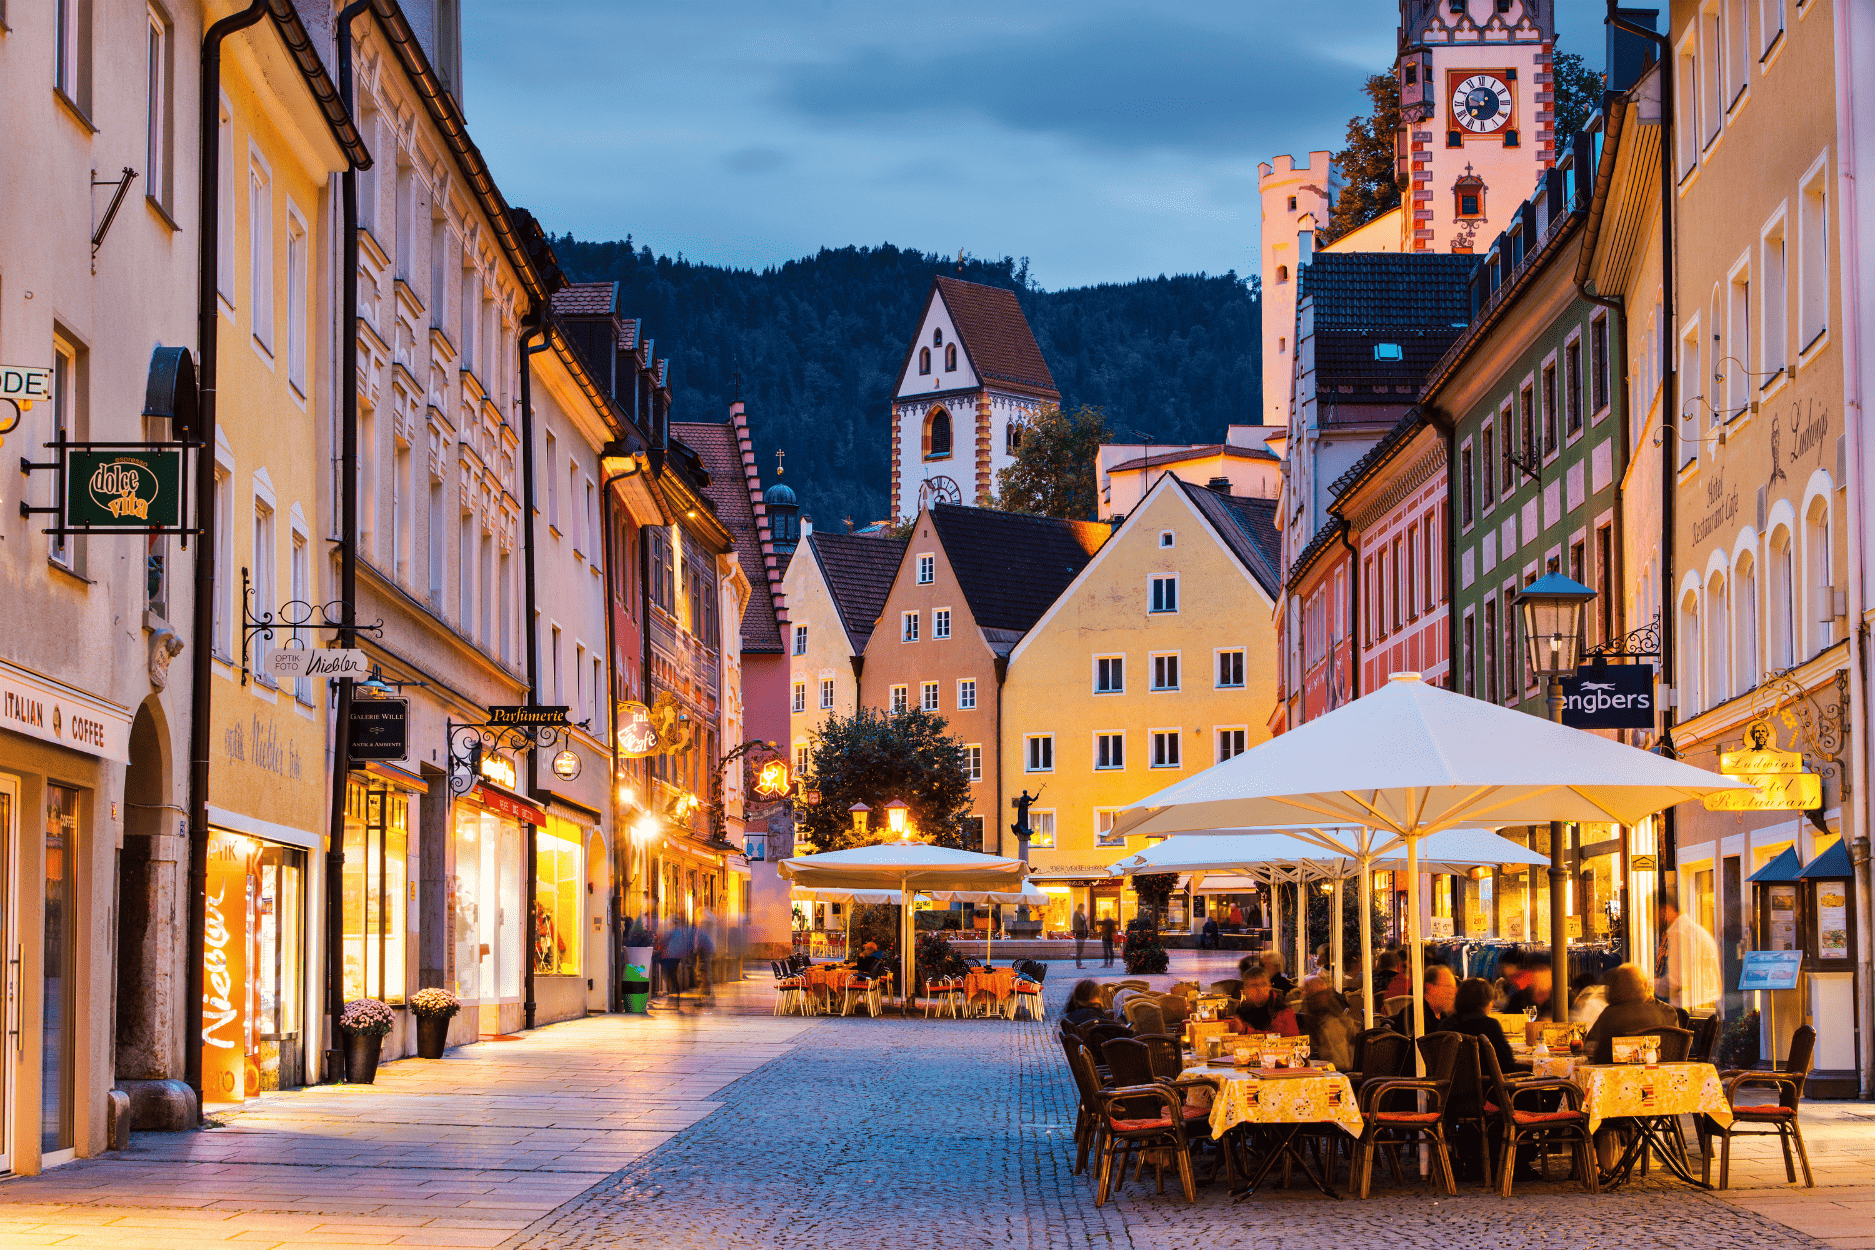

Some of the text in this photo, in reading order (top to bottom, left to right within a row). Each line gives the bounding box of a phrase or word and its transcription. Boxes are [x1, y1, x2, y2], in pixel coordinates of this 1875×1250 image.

[0, 371, 44, 395] DE
[1790, 397, 1828, 467] Ludwigs
[114, 456, 148, 468] espresso
[92, 462, 140, 495] dolce
[1706, 465, 1725, 509] Hotel
[107, 490, 148, 520] vita
[1692, 500, 1725, 547] Restaurant
[275, 654, 303, 663] OPTIK-
[275, 662, 299, 671] FOTO
[4, 690, 104, 748] ITALIAN COFFEE
[492, 706, 564, 724] Parfümerie
[1731, 755, 1795, 771] Ludwigs
[1710, 794, 1817, 808] Restaurant
[207, 839, 237, 861] PTIK
